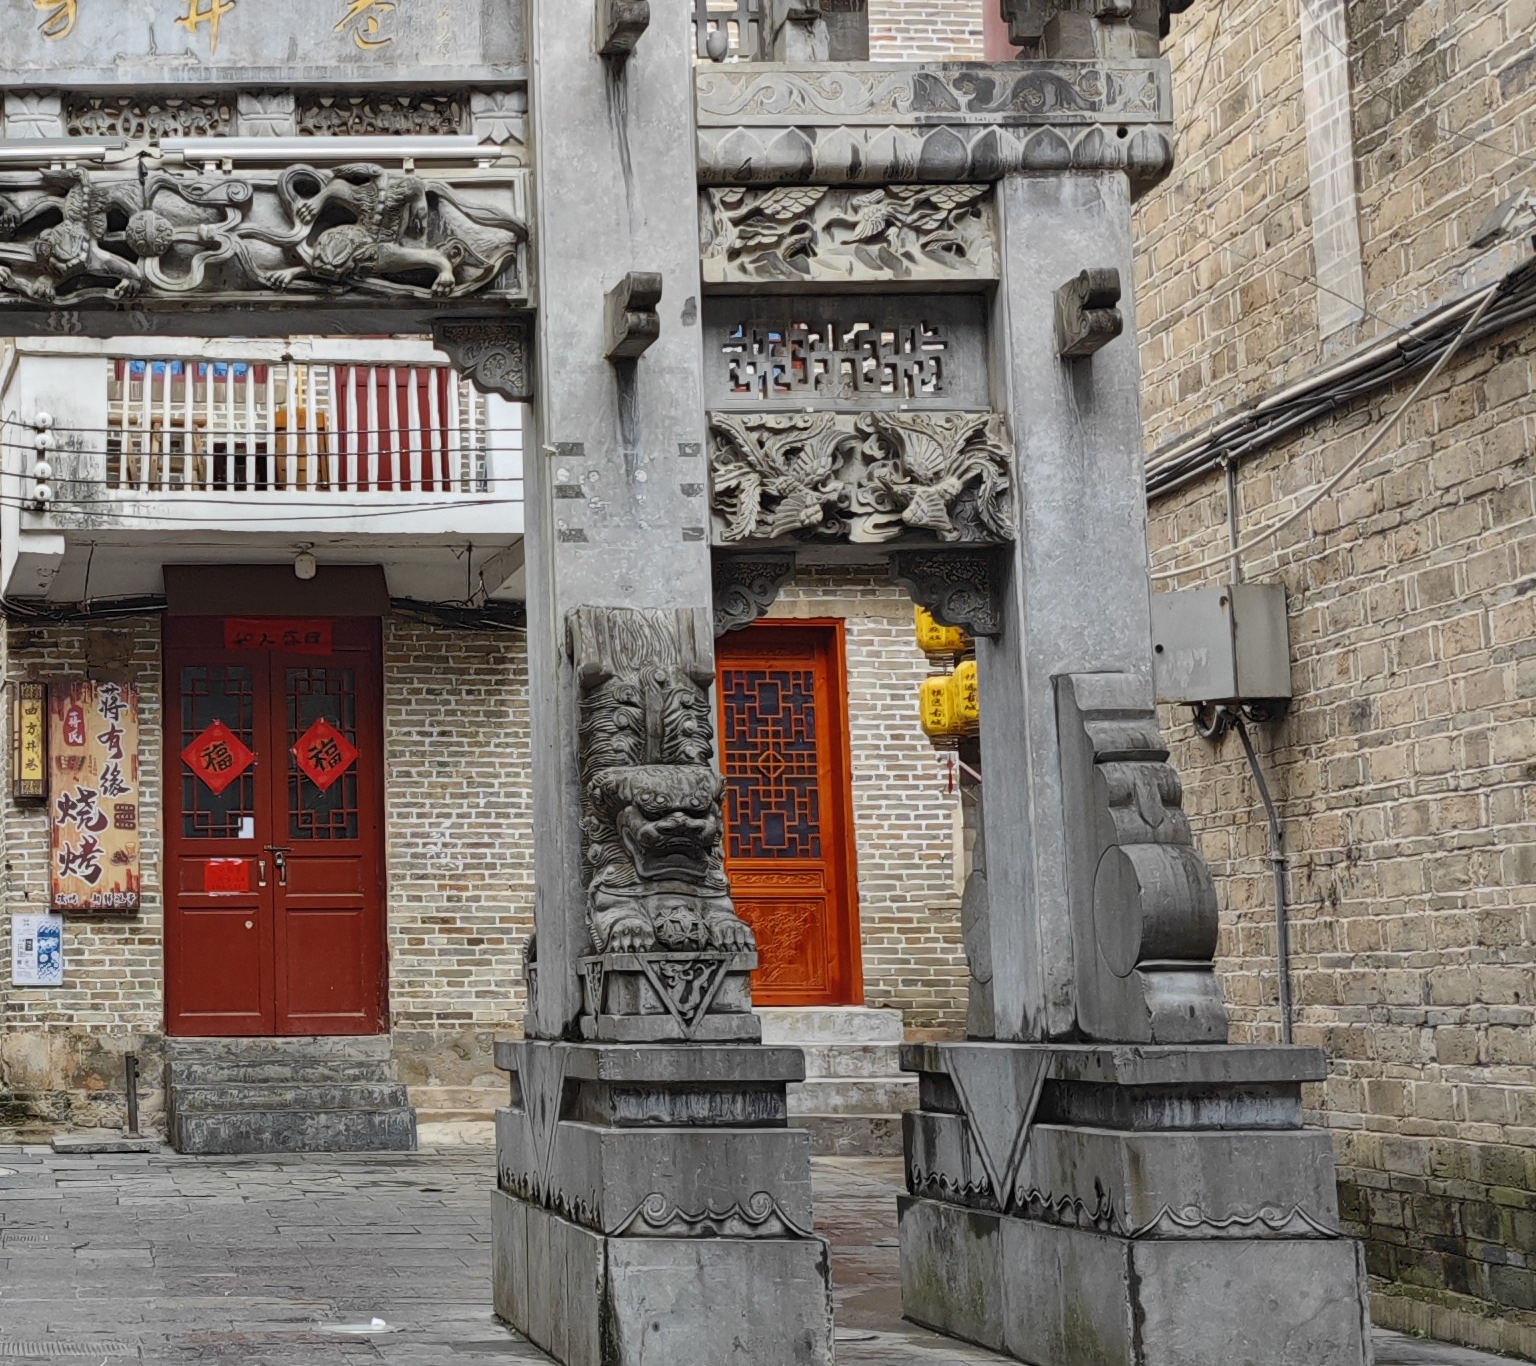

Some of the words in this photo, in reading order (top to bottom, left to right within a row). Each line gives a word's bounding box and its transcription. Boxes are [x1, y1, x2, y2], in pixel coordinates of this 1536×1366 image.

[97, 682, 132, 797] 蒋有缘
[200, 740, 233, 772] 福
[307, 737, 343, 772] 福
[56, 785, 110, 886] 烧烤
